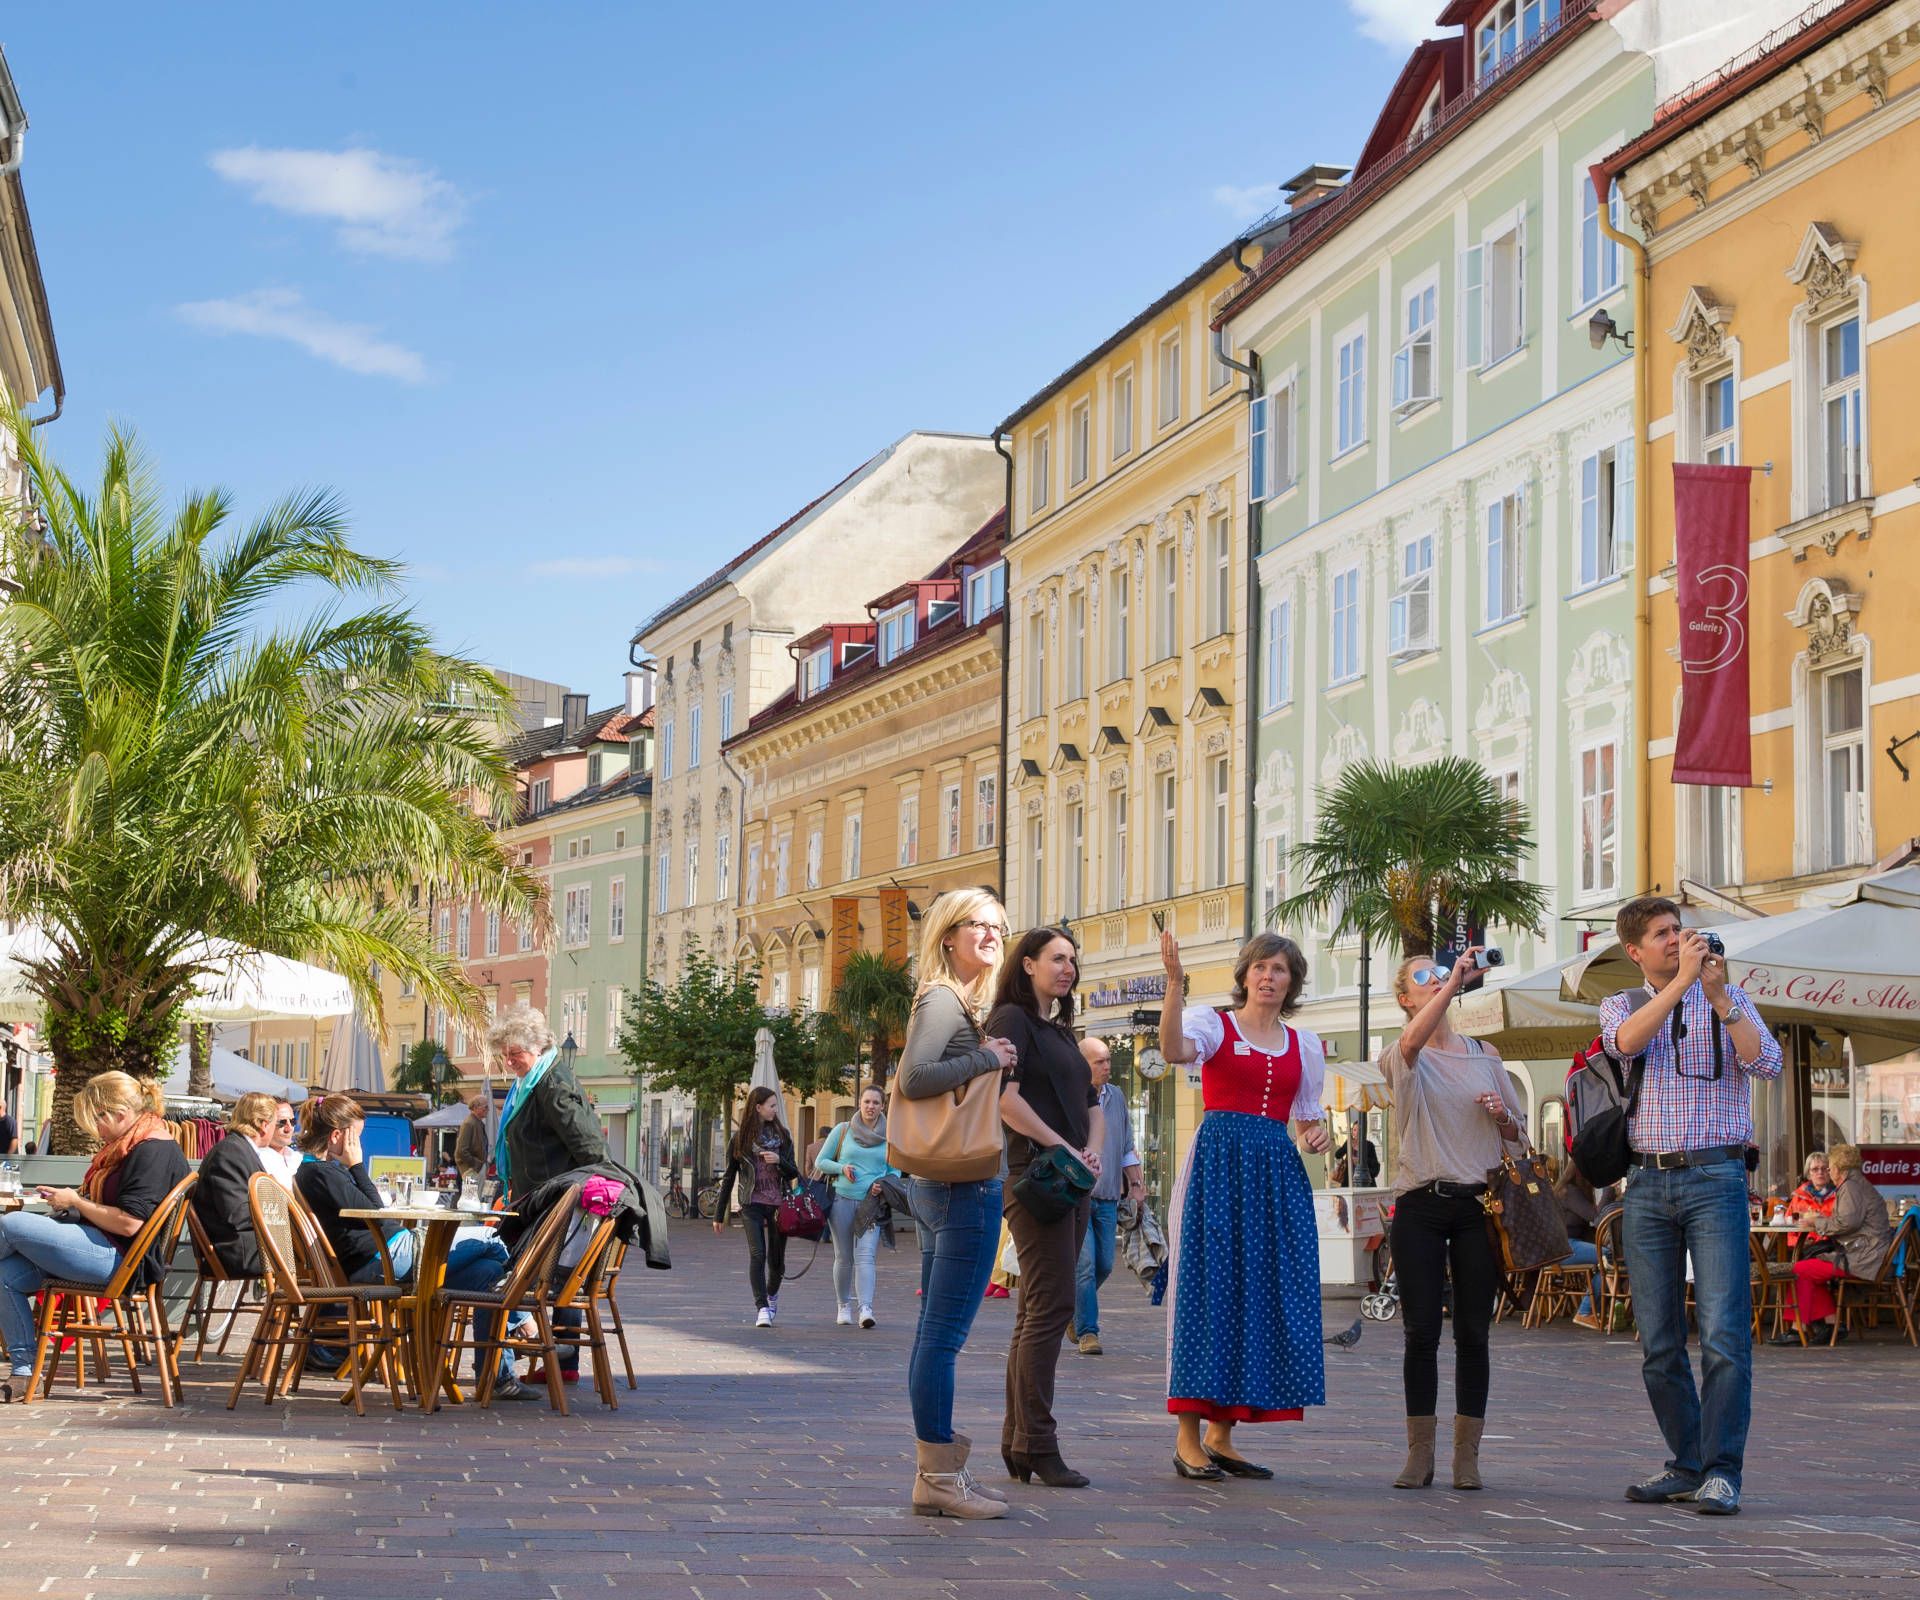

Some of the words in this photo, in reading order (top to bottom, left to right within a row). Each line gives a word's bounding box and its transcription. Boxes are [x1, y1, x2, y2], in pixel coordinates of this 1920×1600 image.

[1683, 564, 1749, 673] 3
[1688, 621, 1718, 633] Galerie
[837, 907, 854, 954] VIVA
[886, 898, 902, 948] VIVA
[1739, 968, 1781, 997] Eis
[1785, 975, 1846, 1008] Café
[1852, 984, 1920, 1010] Alte
[1188, 1075, 1202, 1083] TA
[1862, 1160, 1910, 1175] Galerie
[1911, 1163, 1920, 1176] 3
